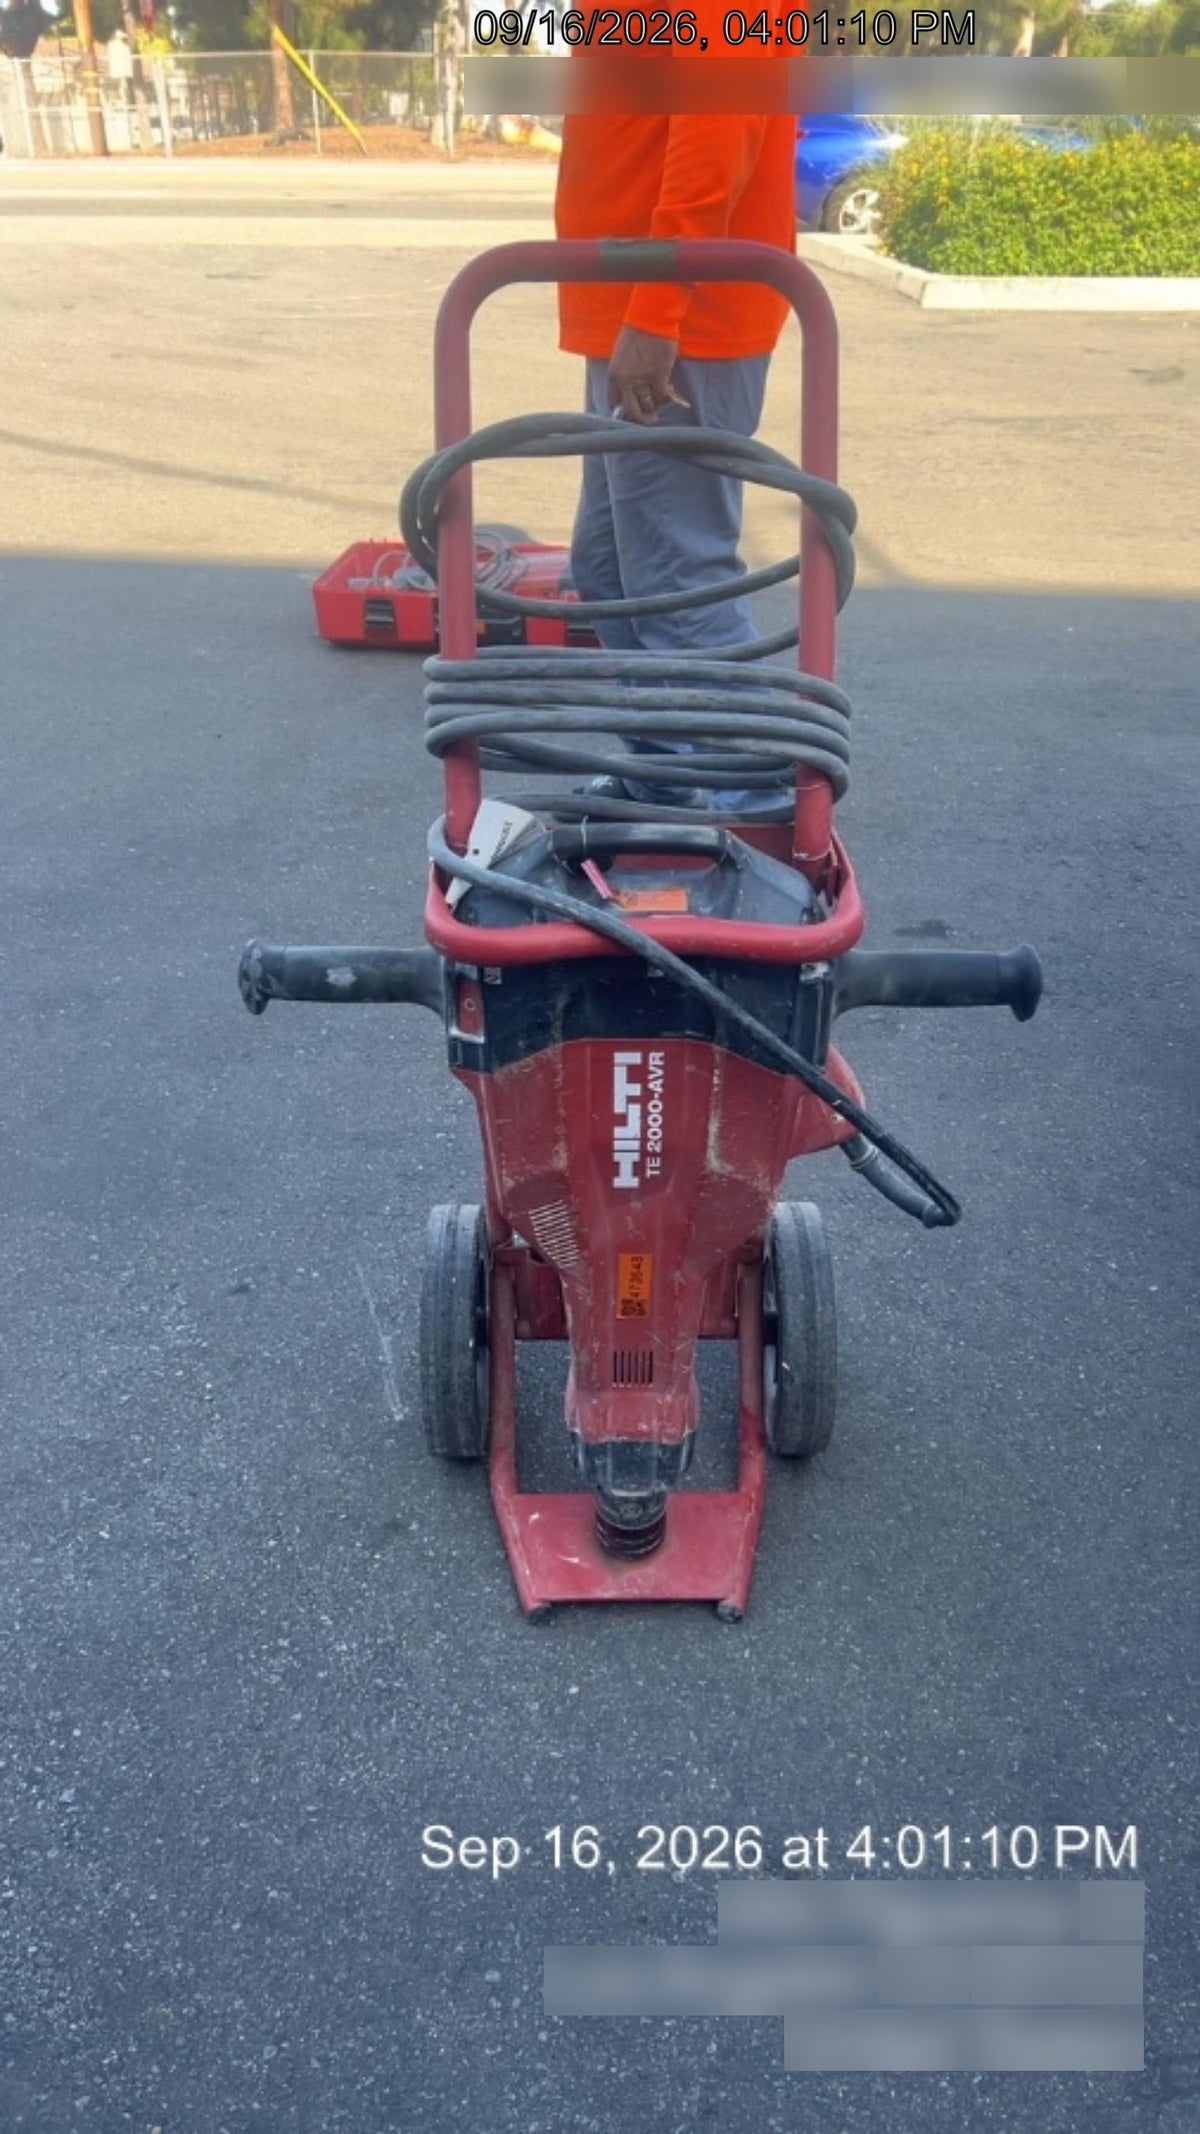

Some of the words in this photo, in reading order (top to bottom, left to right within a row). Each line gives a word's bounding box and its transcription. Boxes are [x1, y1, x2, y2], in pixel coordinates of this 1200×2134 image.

[613, 1052, 642, 1188] HILTI
[647, 1052, 664, 1153] 2000-AVR
[645, 1156, 661, 1178] TE
